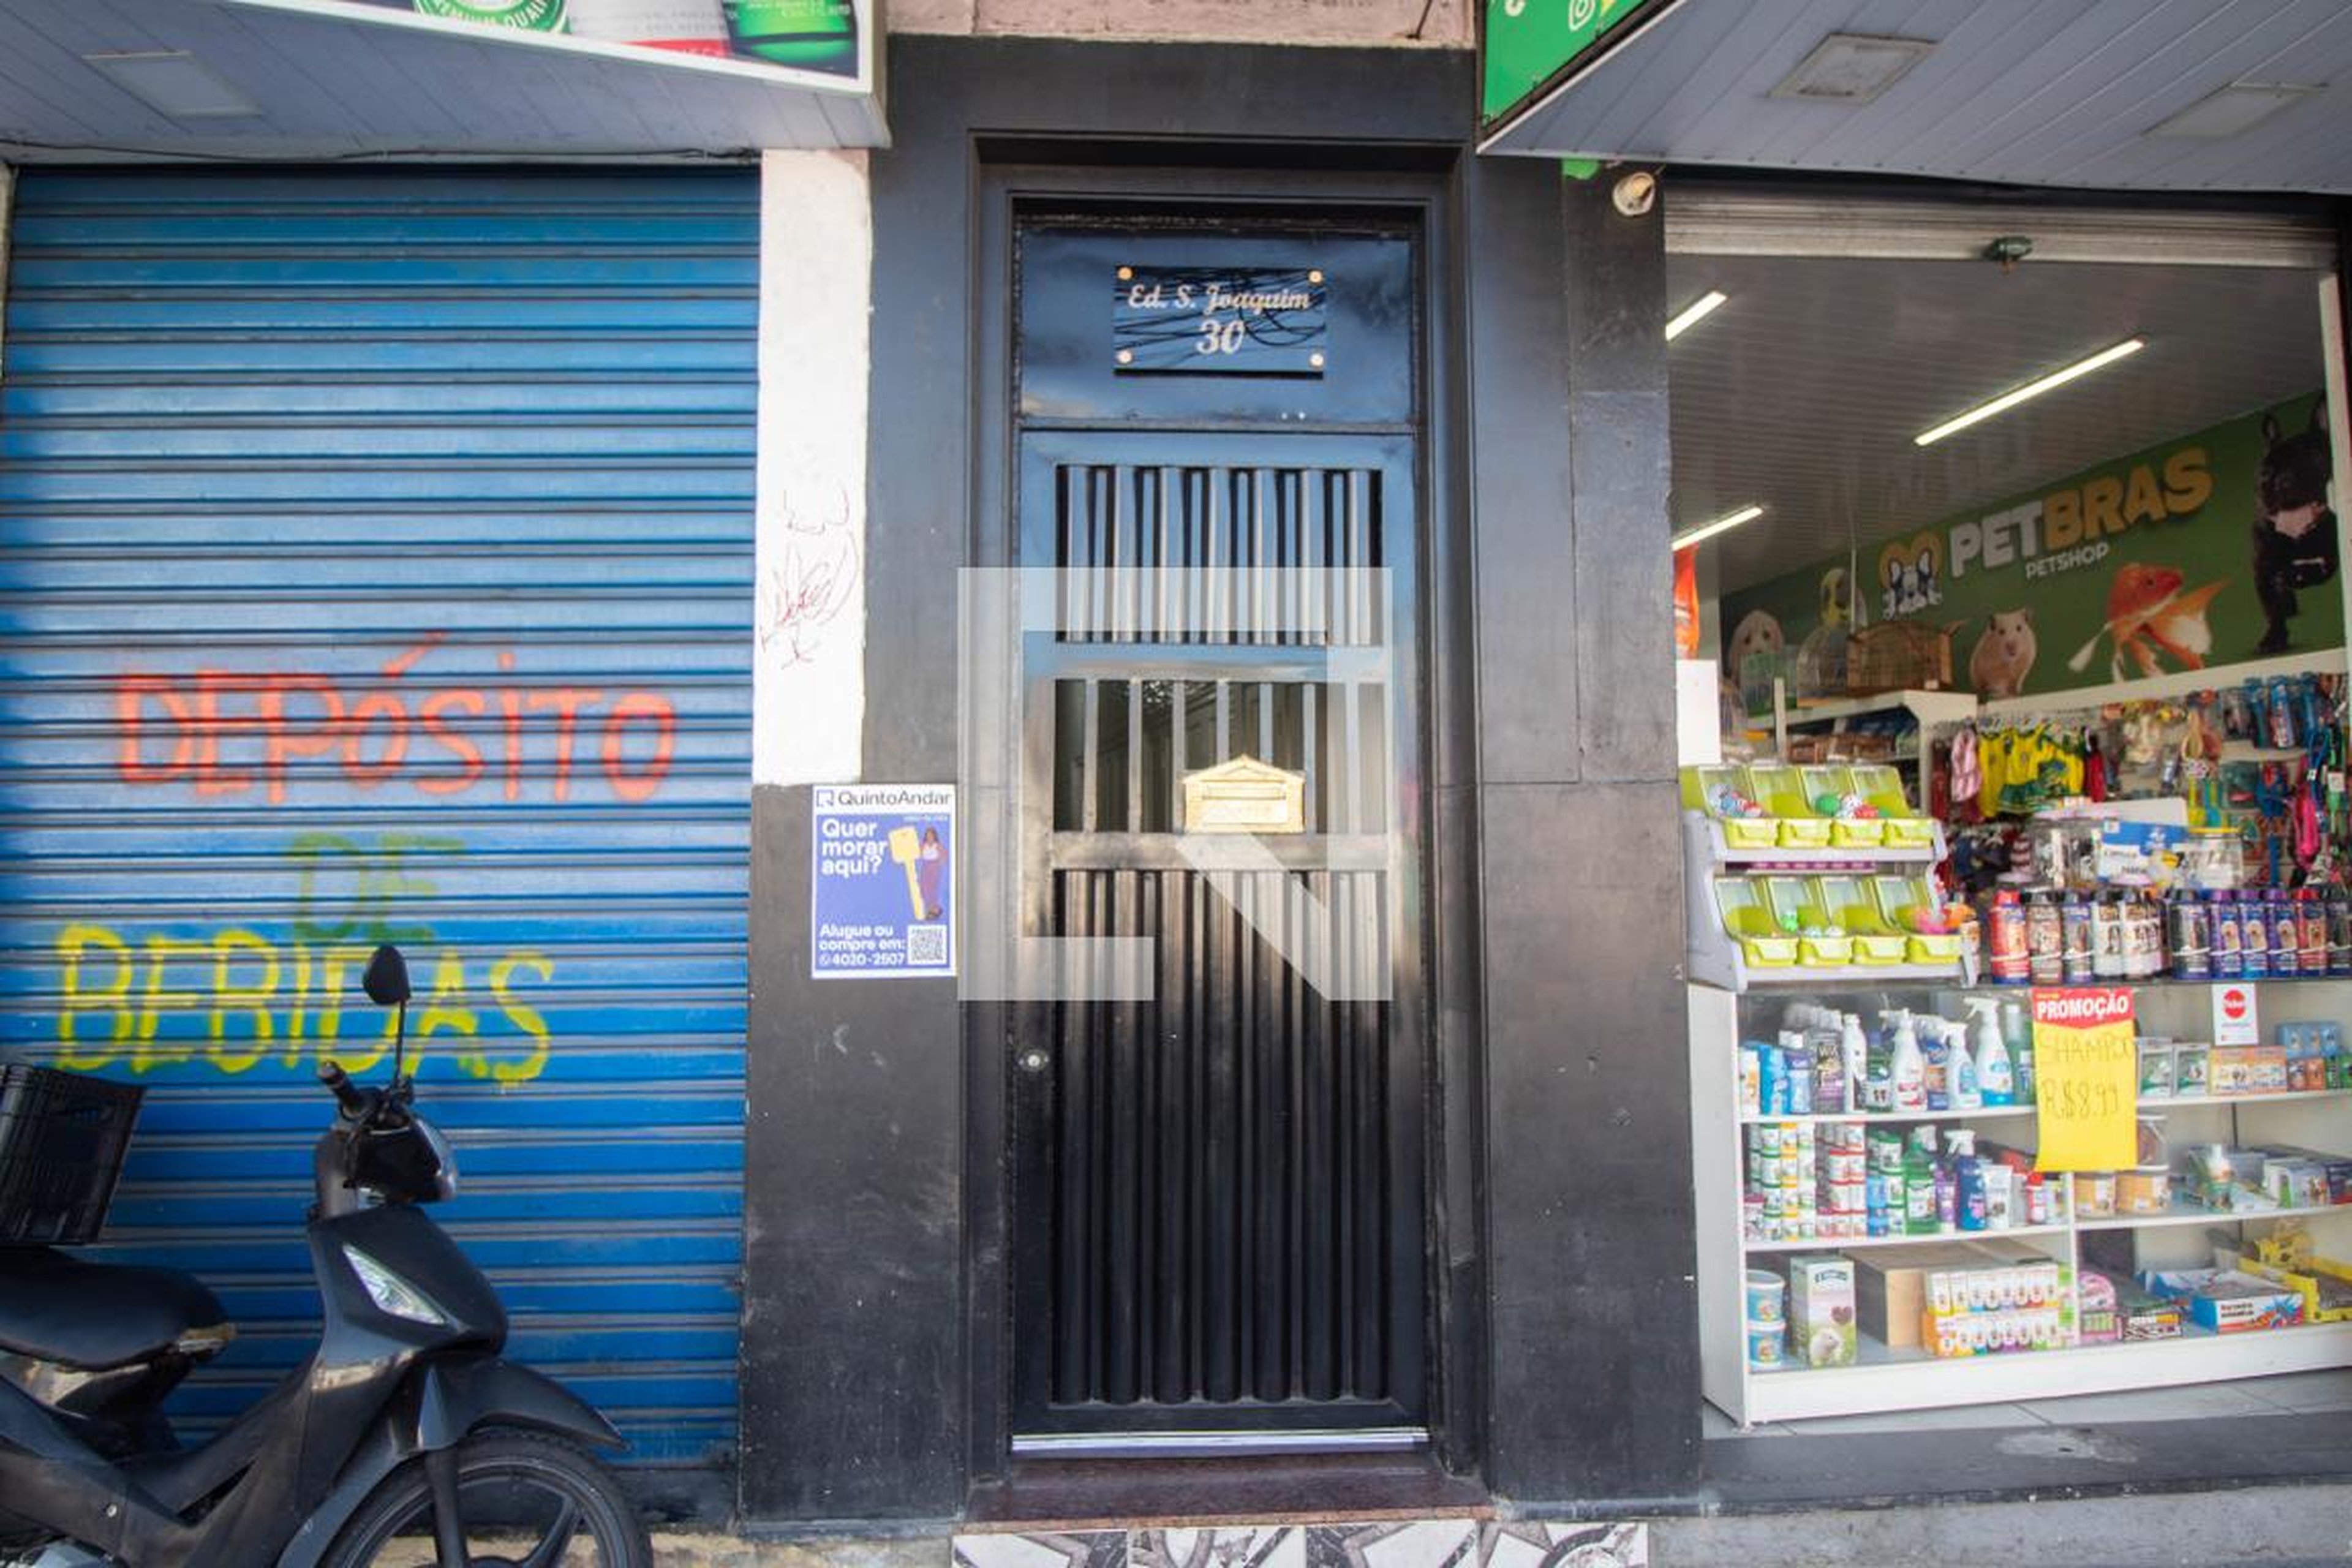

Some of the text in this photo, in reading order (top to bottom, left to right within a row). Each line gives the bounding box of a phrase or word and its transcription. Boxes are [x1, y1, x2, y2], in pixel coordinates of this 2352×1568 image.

[1128, 284, 1313, 316] Ed. S. Joaquim
[1196, 319, 1246, 355] 30
[2024, 541, 2109, 580] PETSHOP
[838, 790, 951, 806] QuintoAndar
[821, 818, 877, 838] Quer
[821, 840, 888, 857] morar
[821, 856, 882, 878] aqui?
[282, 832, 469, 946] DE
[819, 924, 894, 940] Alugue ou
[818, 940, 876, 954] compre
[54, 922, 555, 1083] BEBIDAS
[2037, 992, 2129, 1022] PROMOÇÃO
